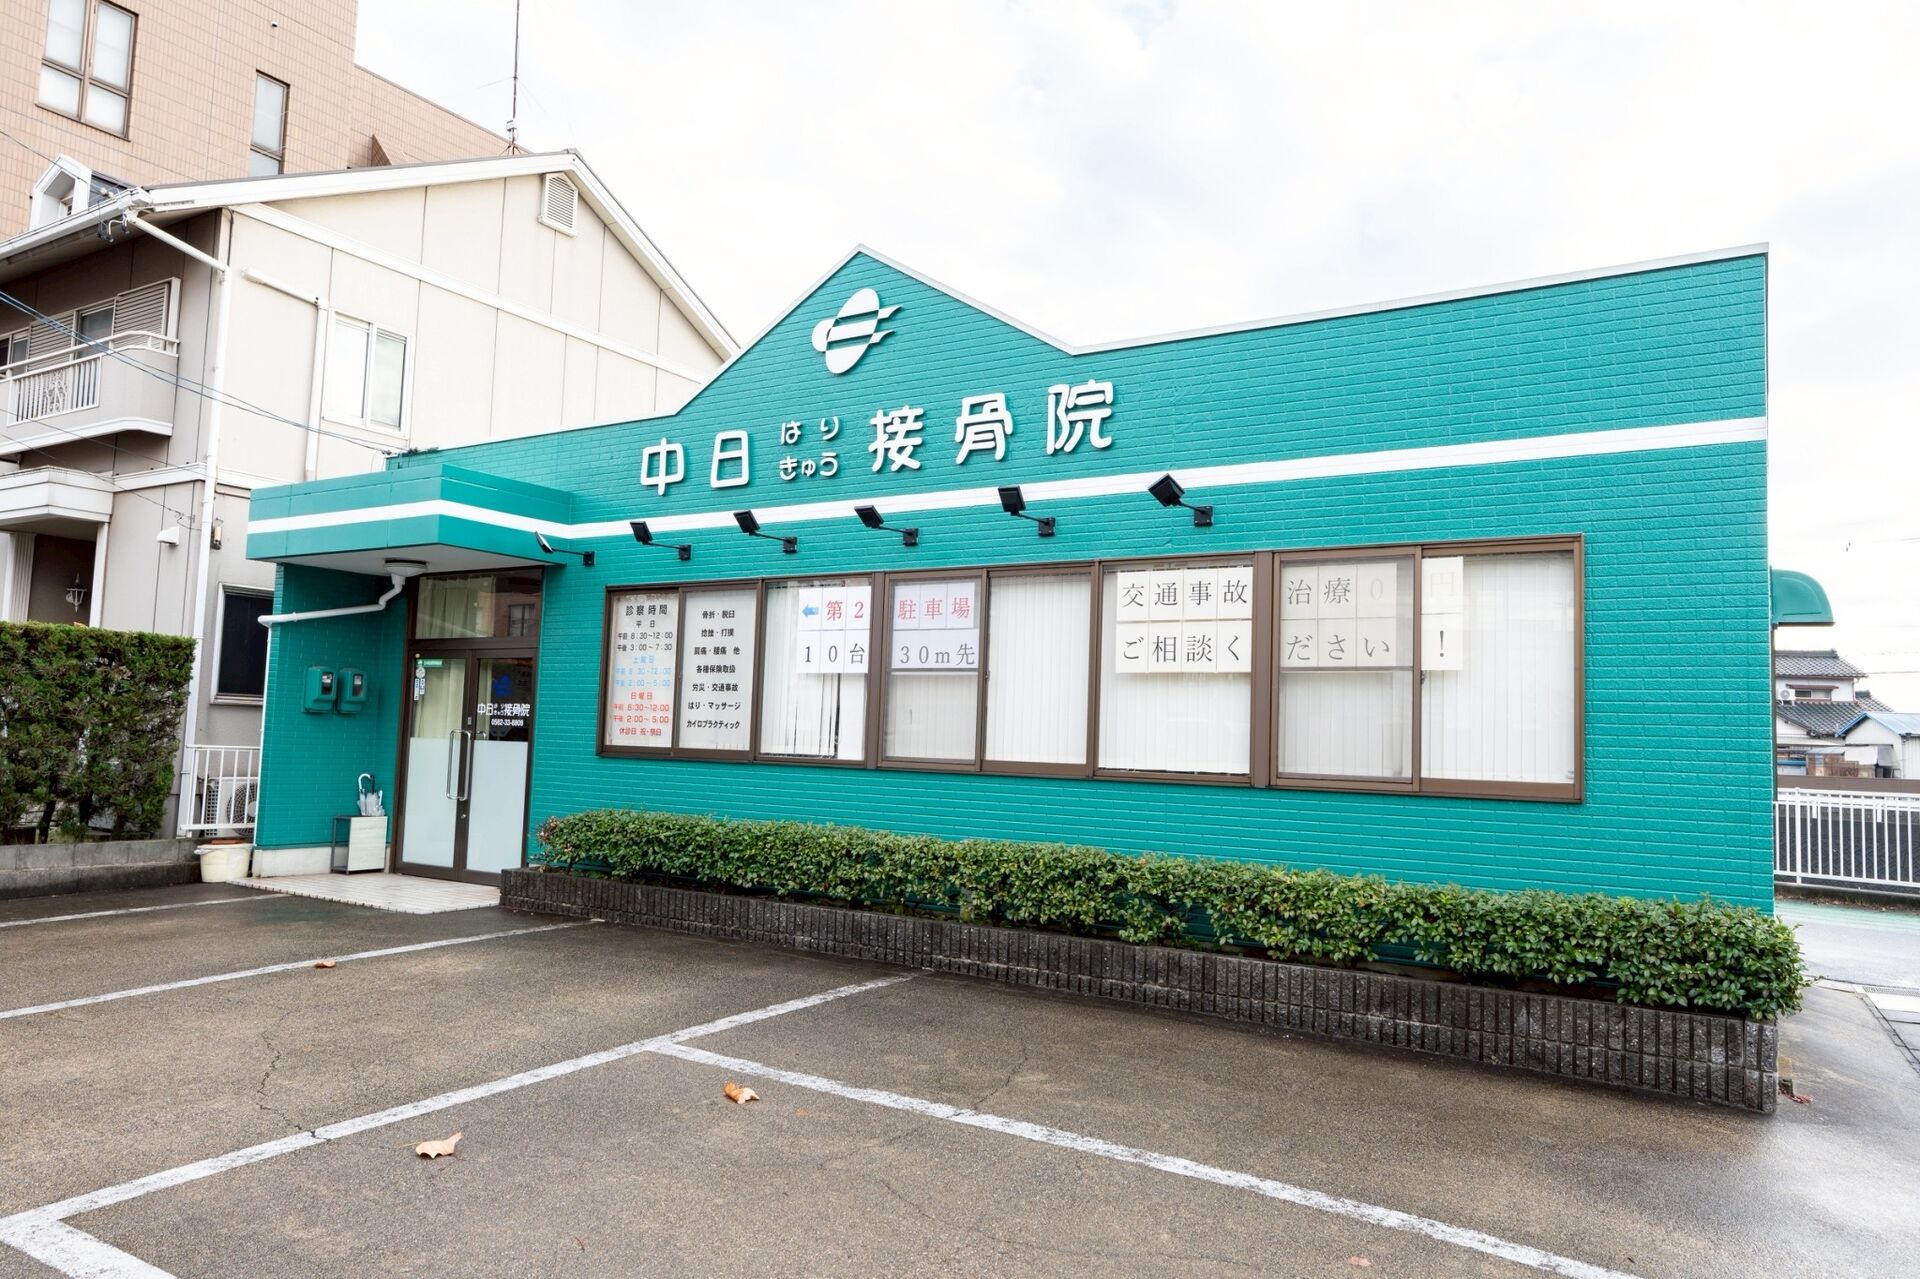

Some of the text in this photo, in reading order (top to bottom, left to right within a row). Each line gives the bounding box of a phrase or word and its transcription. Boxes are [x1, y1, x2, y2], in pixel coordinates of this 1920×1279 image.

[781, 416, 841, 445] はり
[869, 379, 1115, 473] 接骨院
[640, 429, 750, 496] 中日
[779, 451, 839, 481] きゅう
[626, 604, 668, 616] 診察時間
